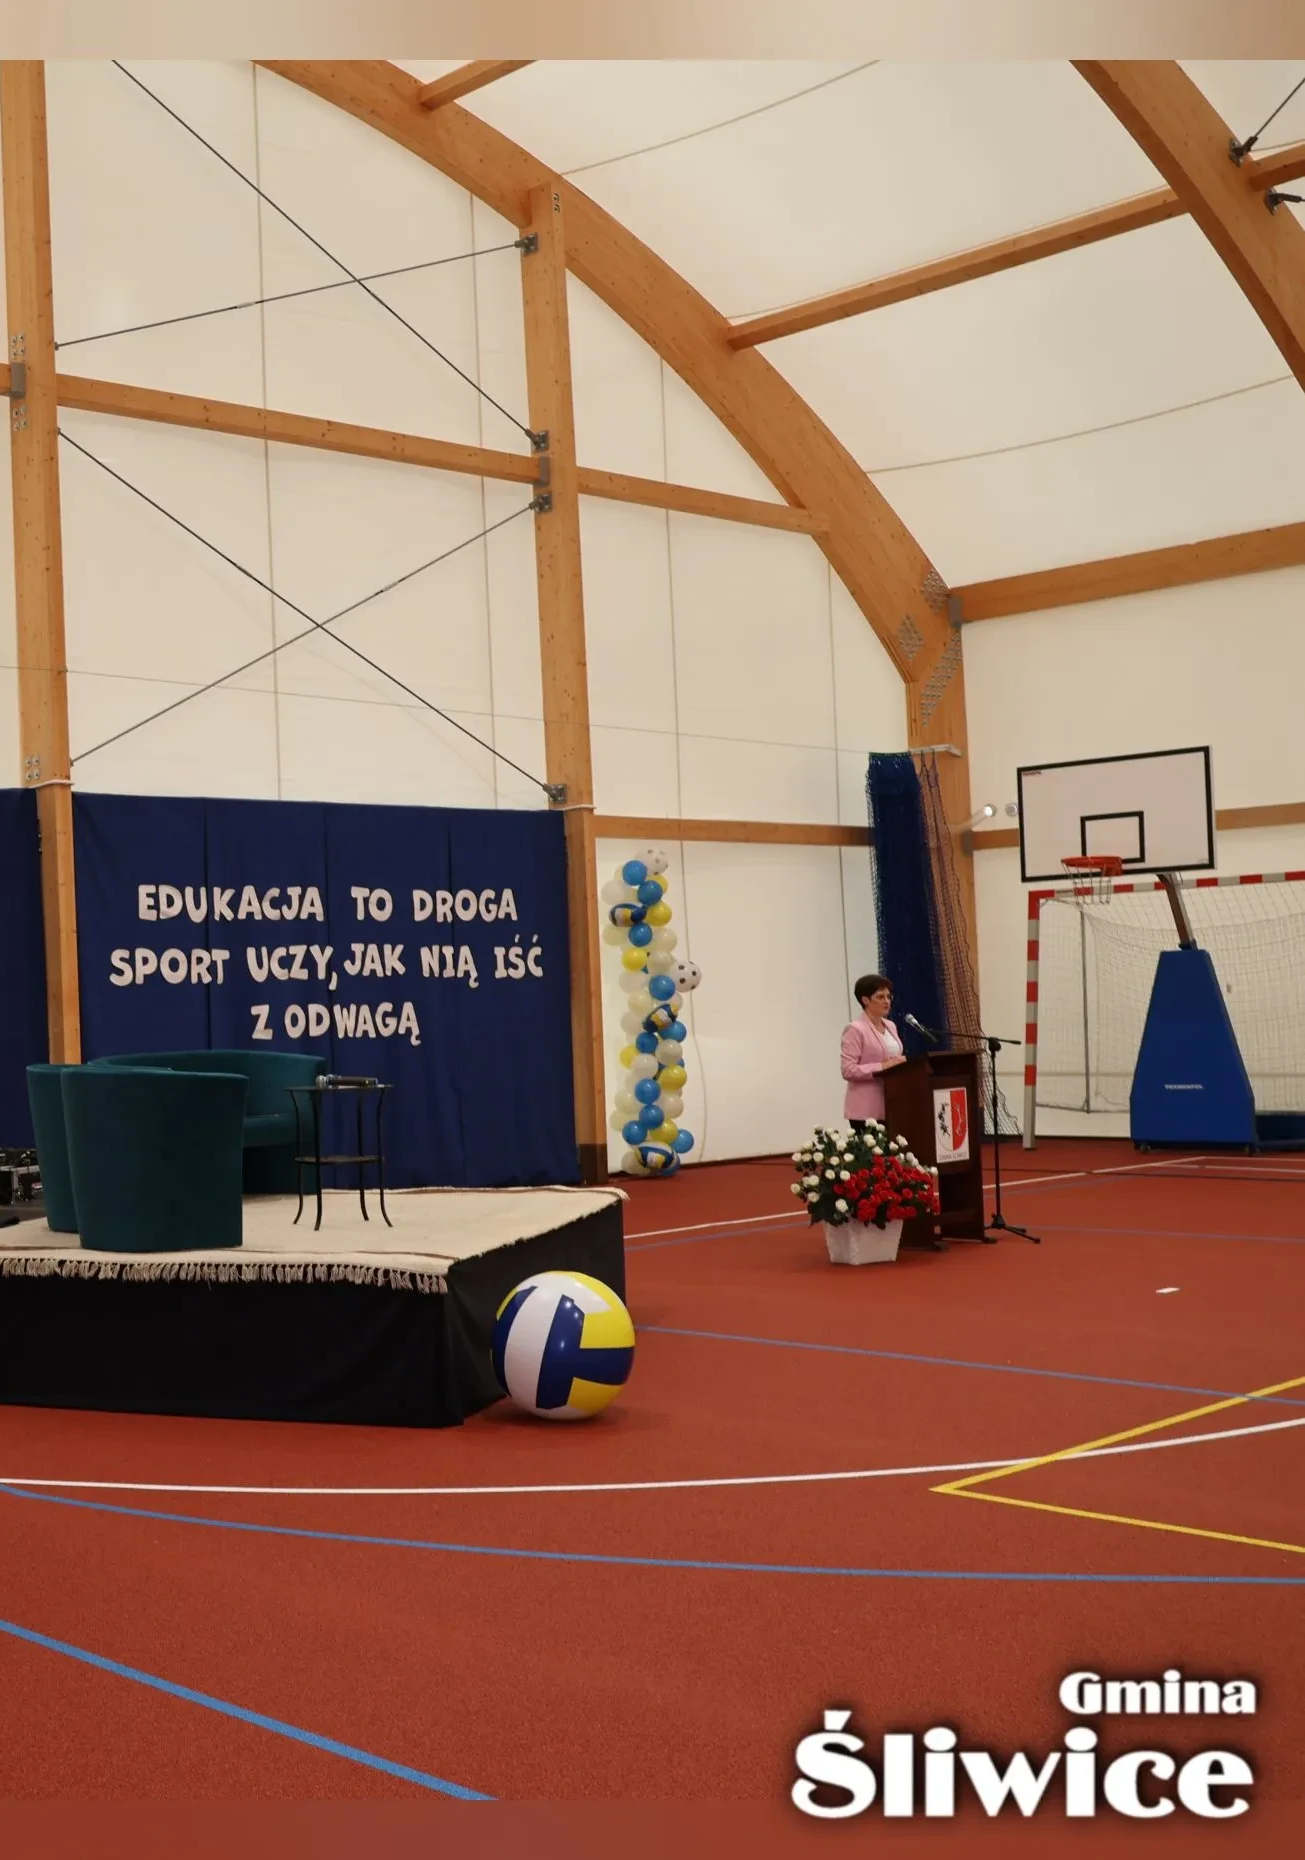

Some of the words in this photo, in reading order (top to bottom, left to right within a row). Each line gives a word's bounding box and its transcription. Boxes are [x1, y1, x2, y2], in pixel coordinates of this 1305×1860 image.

[137, 884, 325, 923] EDUKACJA
[351, 886, 393, 922] TO
[412, 888, 518, 922] DROGA
[109, 947, 230, 987] SPORT
[343, 942, 406, 978] JAK
[420, 944, 479, 988] NIĄ
[494, 934, 544, 980] IŚĆ
[251, 1004, 273, 1040] Z
[284, 1001, 422, 1046] ODWAGĄ
